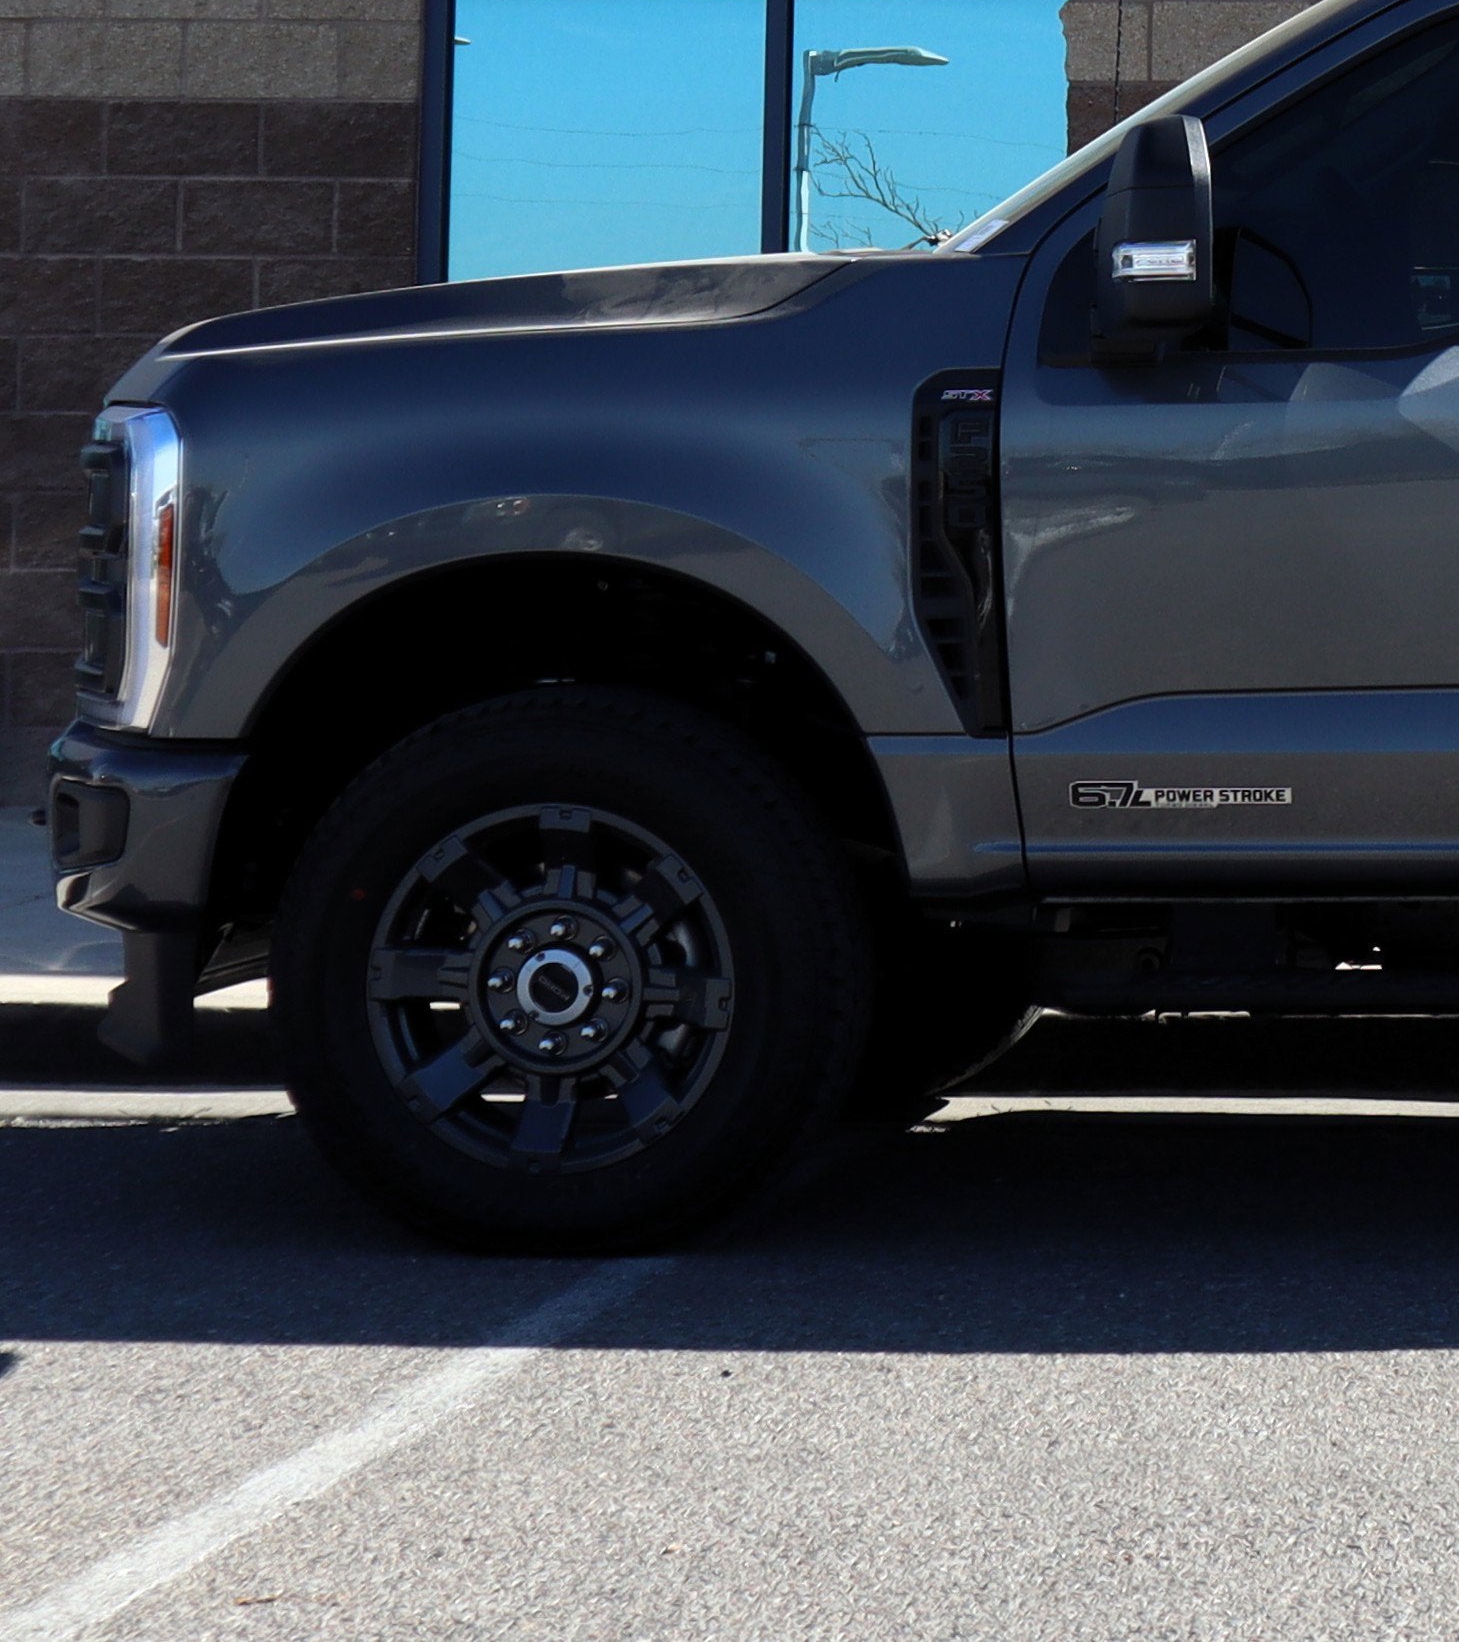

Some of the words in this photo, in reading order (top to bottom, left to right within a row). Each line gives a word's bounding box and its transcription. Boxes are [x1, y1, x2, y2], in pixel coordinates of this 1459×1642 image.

[1069, 780, 1152, 808] 6.7L
[1154, 789, 1214, 803] POWER
[1218, 789, 1287, 804] STROKE
